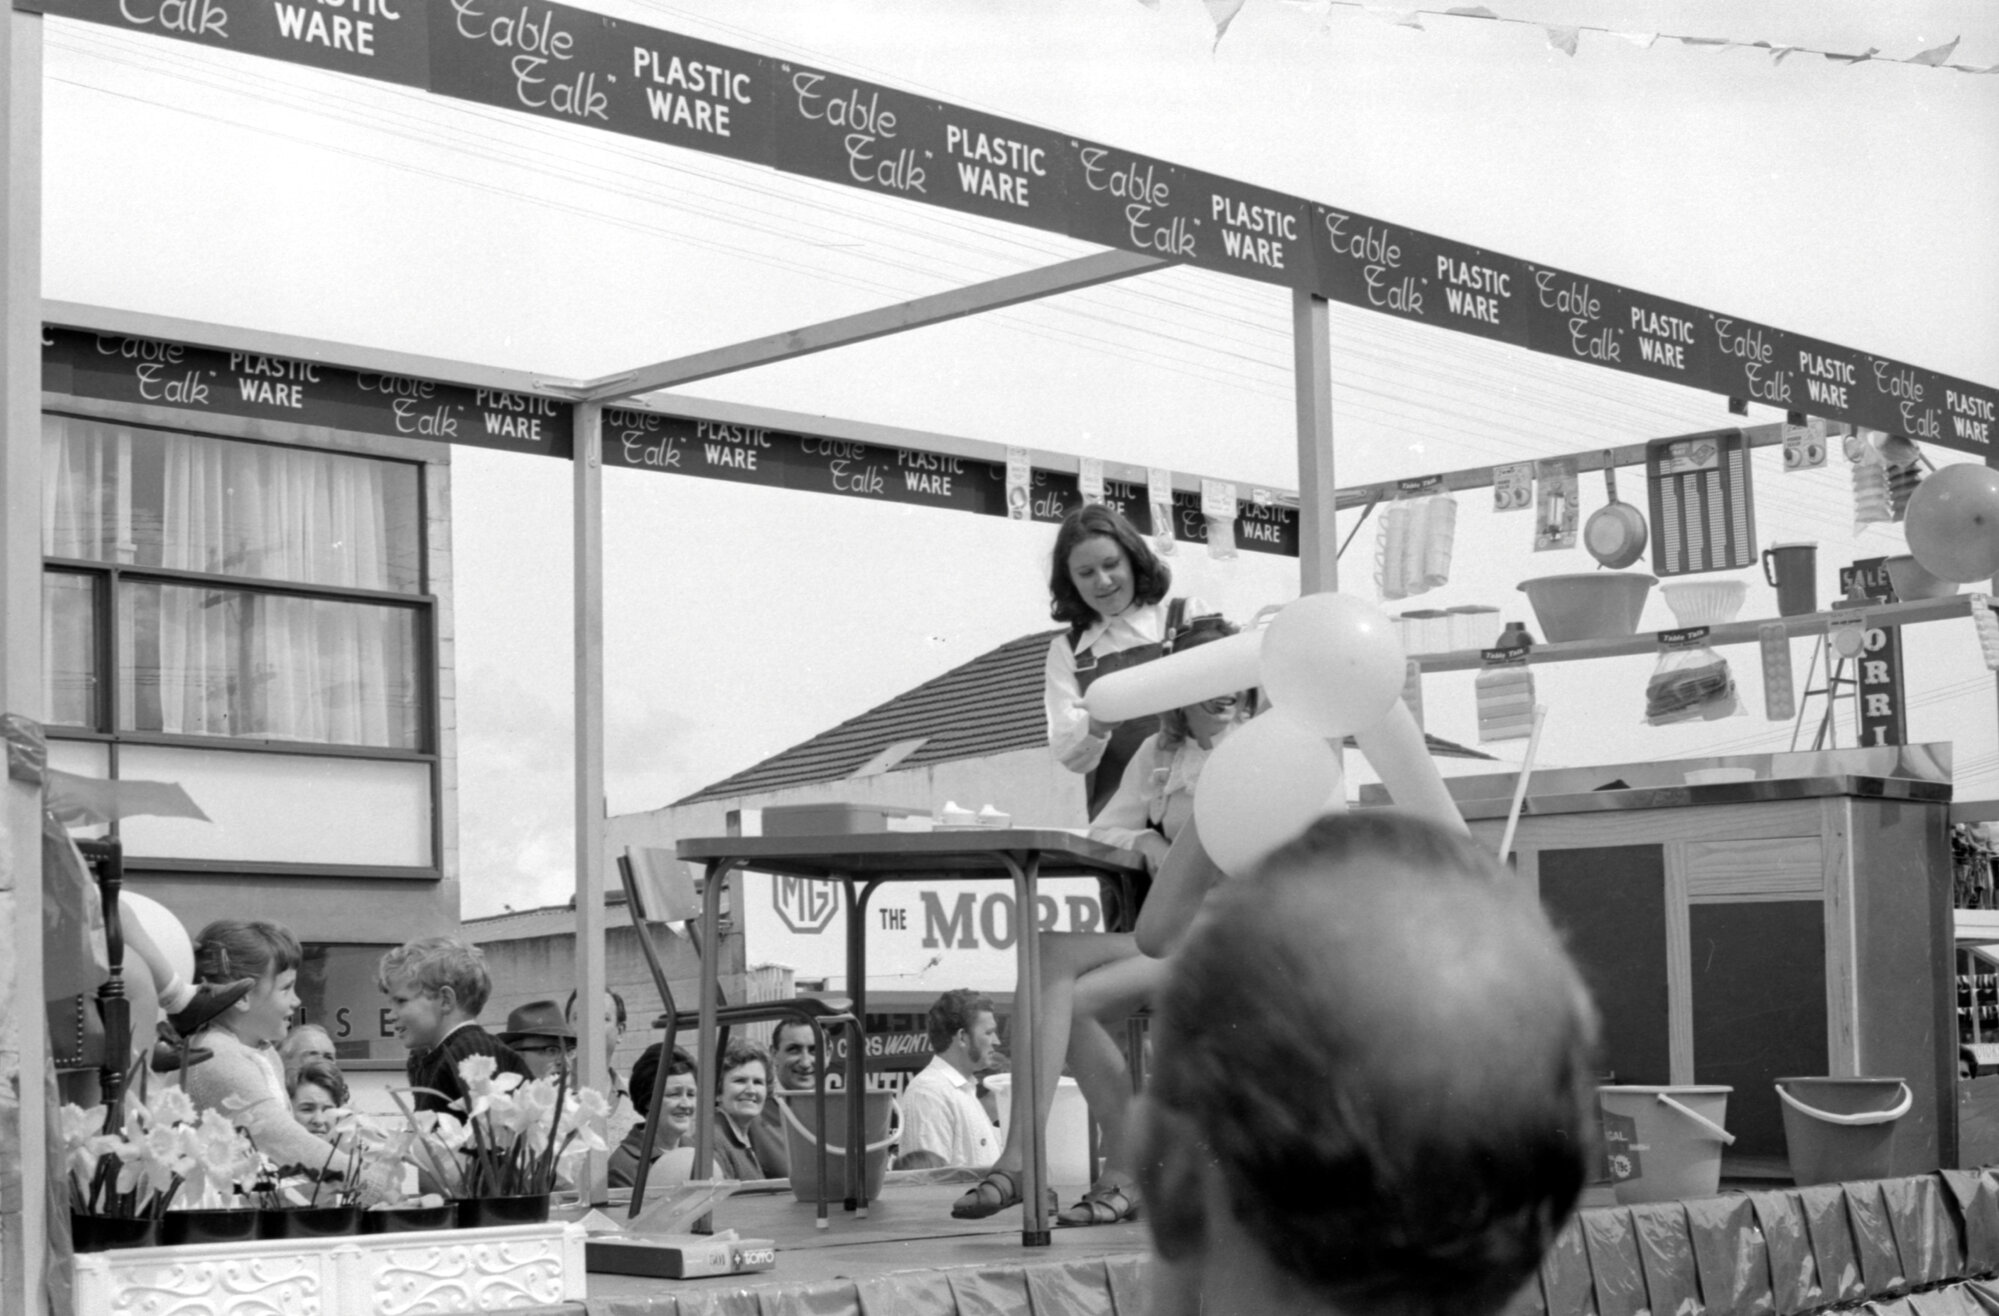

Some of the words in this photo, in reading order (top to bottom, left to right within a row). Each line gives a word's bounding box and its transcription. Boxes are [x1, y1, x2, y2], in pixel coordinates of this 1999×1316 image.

[274, 1, 375, 56] WARE
[633, 46, 751, 104] PLASTIC
[646, 87, 731, 137] WARE
[947, 125, 1046, 176] PLASTIC
[958, 162, 1029, 207] WARE
[1212, 194, 1297, 241] PLASTIC
[1221, 229, 1284, 269] WARE
[1437, 255, 1511, 298] PLASTIC
[1446, 287, 1500, 325] WARE
[1631, 306, 1695, 344] PLASTIC
[230, 350, 320, 383] PLASTIC
[1639, 336, 1685, 370] WARE
[1799, 350, 1856, 385] PLASTIC
[239, 378, 303, 408] WARE
[476, 388, 557, 417] PLASTIC
[1807, 378, 1848, 409] WARE
[1946, 389, 1996, 422] PLASTIC
[484, 412, 541, 440] WARE
[601, 407, 661, 431] able
[697, 420, 772, 448] PLASTIC
[1953, 415, 1990, 444] WARE
[704, 443, 757, 471] WARE
[898, 449, 965, 475] PLASTIC
[904, 470, 952, 496] WARE
[1103, 481, 1136, 500] STIC
[1032, 490, 1069, 518] alk"
[1106, 501, 1126, 517] RE
[1238, 501, 1291, 524] PLASTIC
[1182, 510, 1208, 538] Ta
[1242, 519, 1281, 543] WARE
[1863, 600, 1893, 746] ORRI
[781, 876, 829, 922] MG
[879, 907, 907, 931] THE
[300, 1007, 396, 1037] ISE
[837, 1036, 883, 1058] CRS
[884, 1032, 935, 1055] WANT
